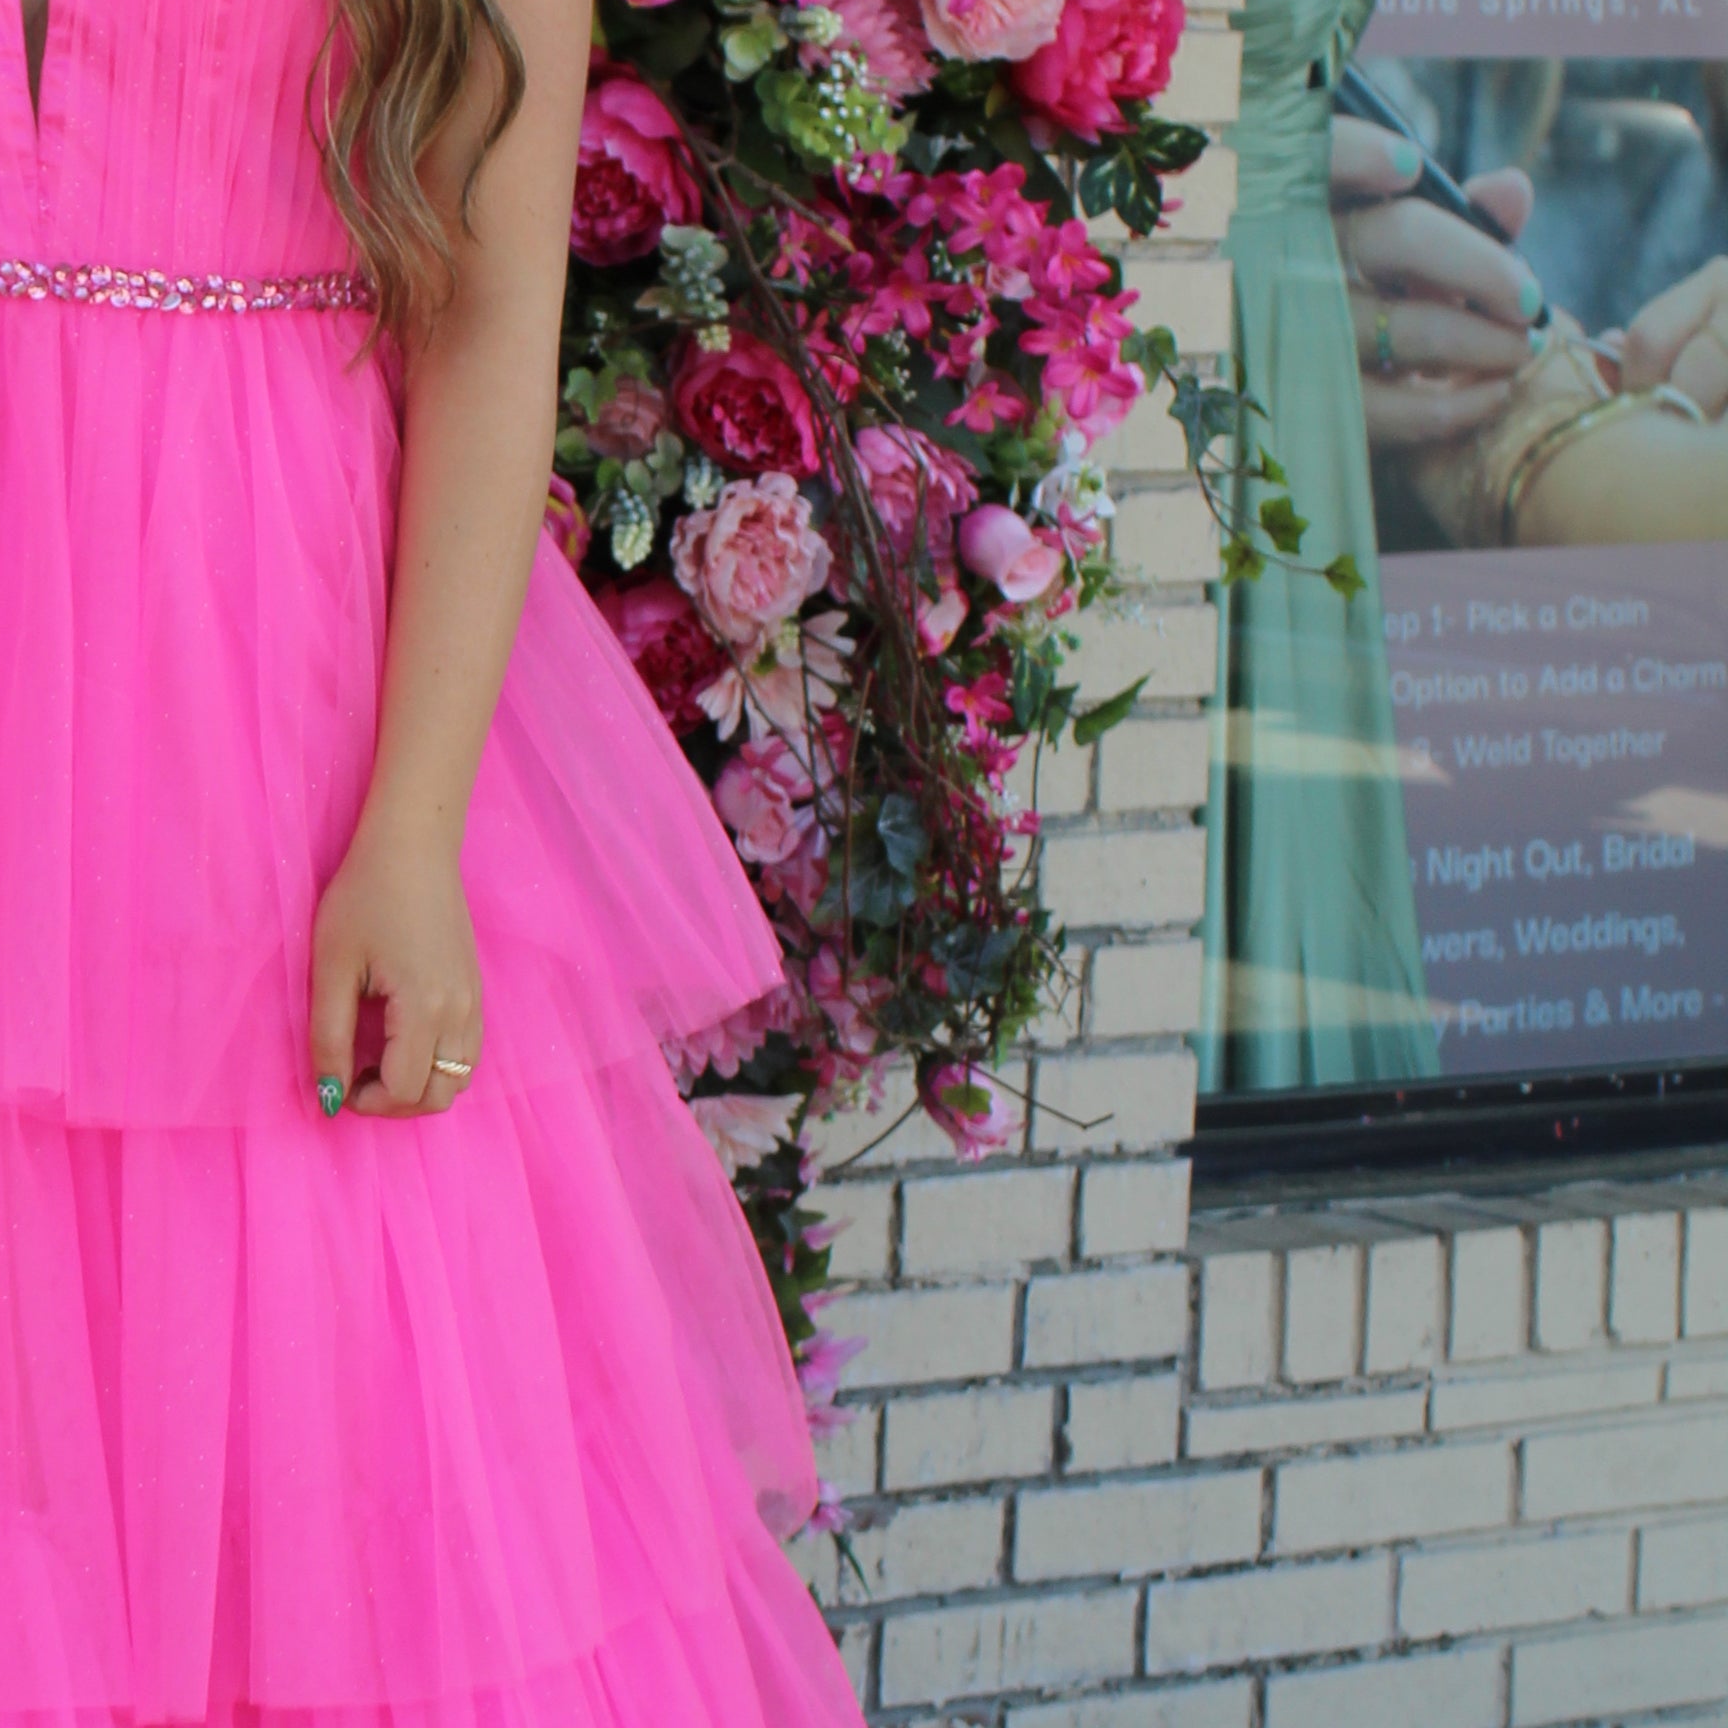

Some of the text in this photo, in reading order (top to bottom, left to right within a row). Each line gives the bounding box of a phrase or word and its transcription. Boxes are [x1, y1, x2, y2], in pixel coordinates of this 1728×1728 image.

[1467, 598, 1530, 635] Pick
[1537, 603, 1558, 631] a
[1565, 595, 1650, 632] Chain
[1390, 669, 1490, 711] Option
[1498, 669, 1529, 700] to
[1538, 663, 1599, 699] Add
[1605, 666, 1625, 694] a
[1453, 732, 1532, 769] Weld
[1541, 726, 1667, 771] Together
[1426, 844, 1515, 893] Night
[1524, 837, 1593, 881] Out,
[1602, 830, 1696, 873] Bridal
[1513, 910, 1687, 957] Weddings,
[1459, 993, 1573, 1037] Parties
[1583, 986, 1612, 1029] &
[1620, 982, 1705, 1022] More
